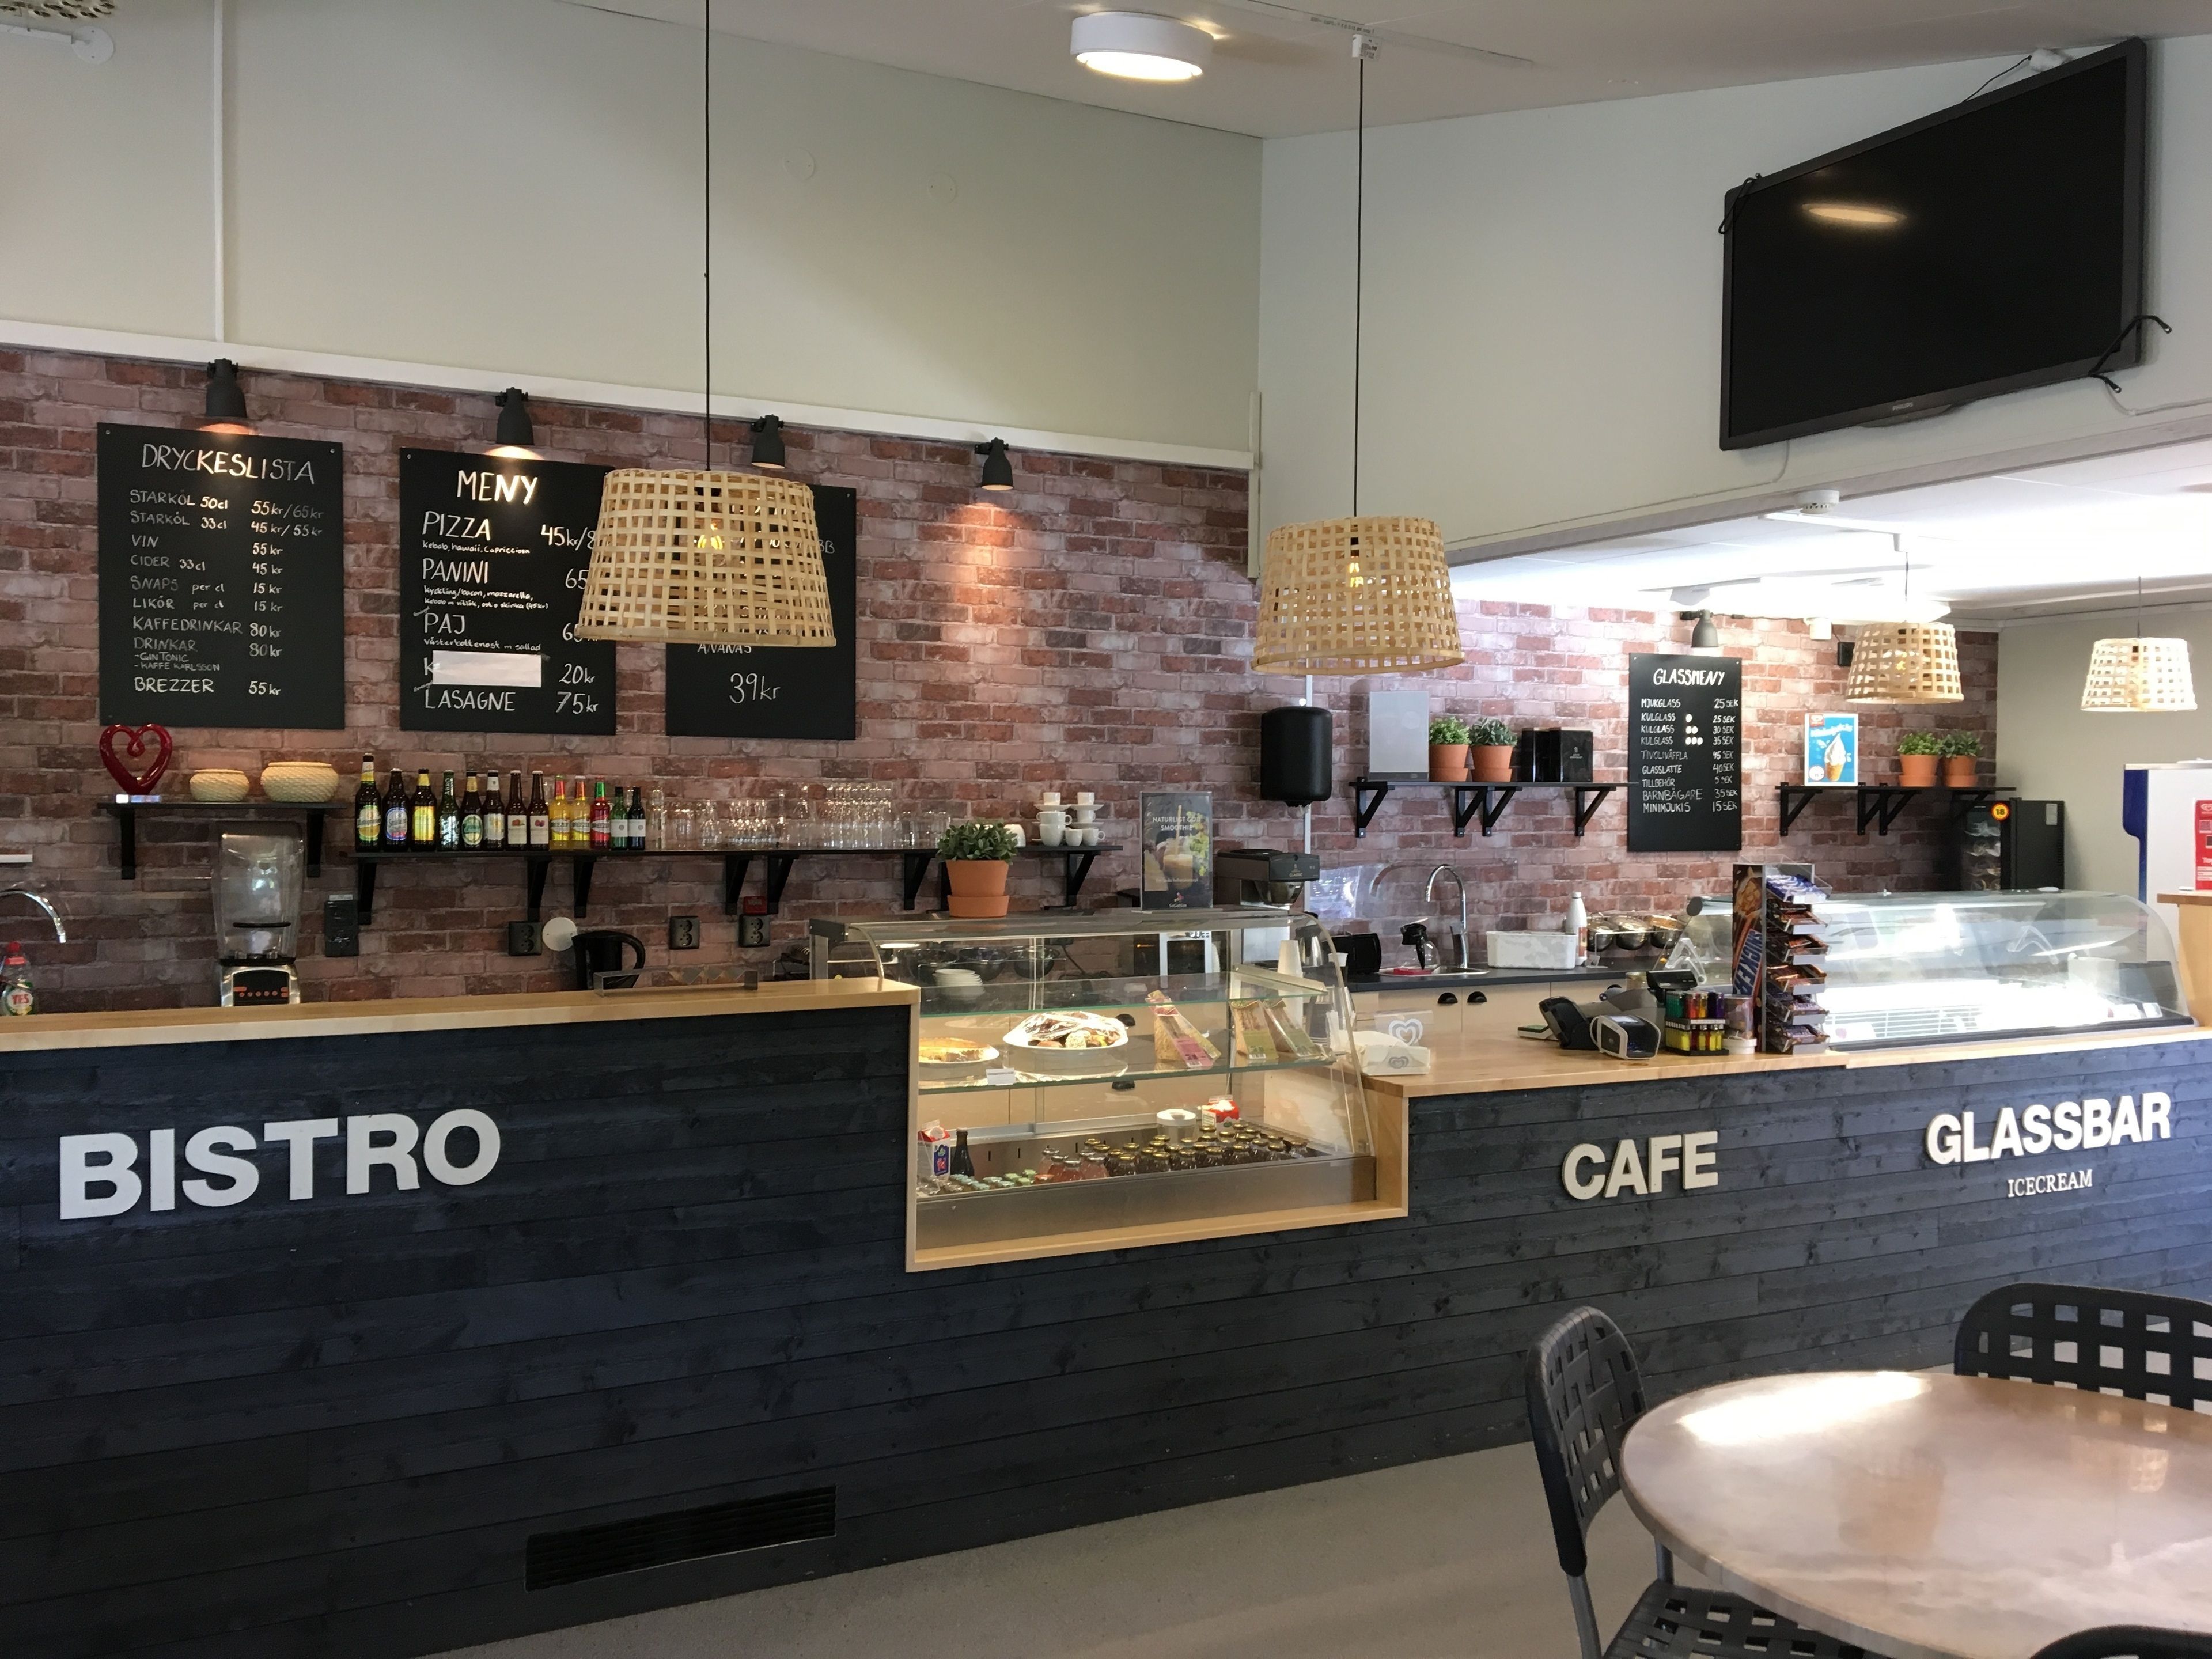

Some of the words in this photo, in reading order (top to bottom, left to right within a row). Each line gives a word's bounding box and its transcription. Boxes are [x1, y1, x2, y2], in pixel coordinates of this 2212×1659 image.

[142, 443, 315, 484] DRYCKESLISTA
[457, 469, 538, 505] MENY
[130, 489, 195, 506] STARKÖL
[200, 496, 228, 510] 50cl
[201, 517, 227, 529] 33cl
[422, 510, 491, 541] PIZZA
[131, 534, 159, 548] VIN
[130, 555, 170, 567] CIDER
[423, 558, 488, 584] PANINI
[130, 575, 179, 591] SNAPS
[192, 584, 210, 594] per
[193, 602, 207, 610] per
[133, 616, 243, 634] KAFFEDRINKAR
[424, 612, 465, 634] PAJ
[134, 637, 198, 652] DRINKAR
[173, 663, 220, 671] KARLSSON
[134, 676, 214, 693] BREZZER
[1653, 668, 1725, 685] GLASSMENY
[729, 673, 781, 703] 39kr
[425, 690, 516, 711] LASAGNE
[1641, 698, 1681, 708] MJUKGLASS
[1641, 713, 1676, 721] KULGLASS
[1641, 725, 1675, 733] KULGLASS
[1641, 736, 1673, 745] KULGLASS
[1642, 764, 1682, 774] GLASSLATTE
[1643, 802, 1691, 813] MINIMJUKIS
[12, 994, 29, 1005] YES
[1926, 1091, 2171, 1166] GLASSBAR
[59, 1108, 501, 1220] BISTRO
[1562, 1130, 1719, 1200] CAFE
[2006, 1169, 2093, 1198] ICECREAM
